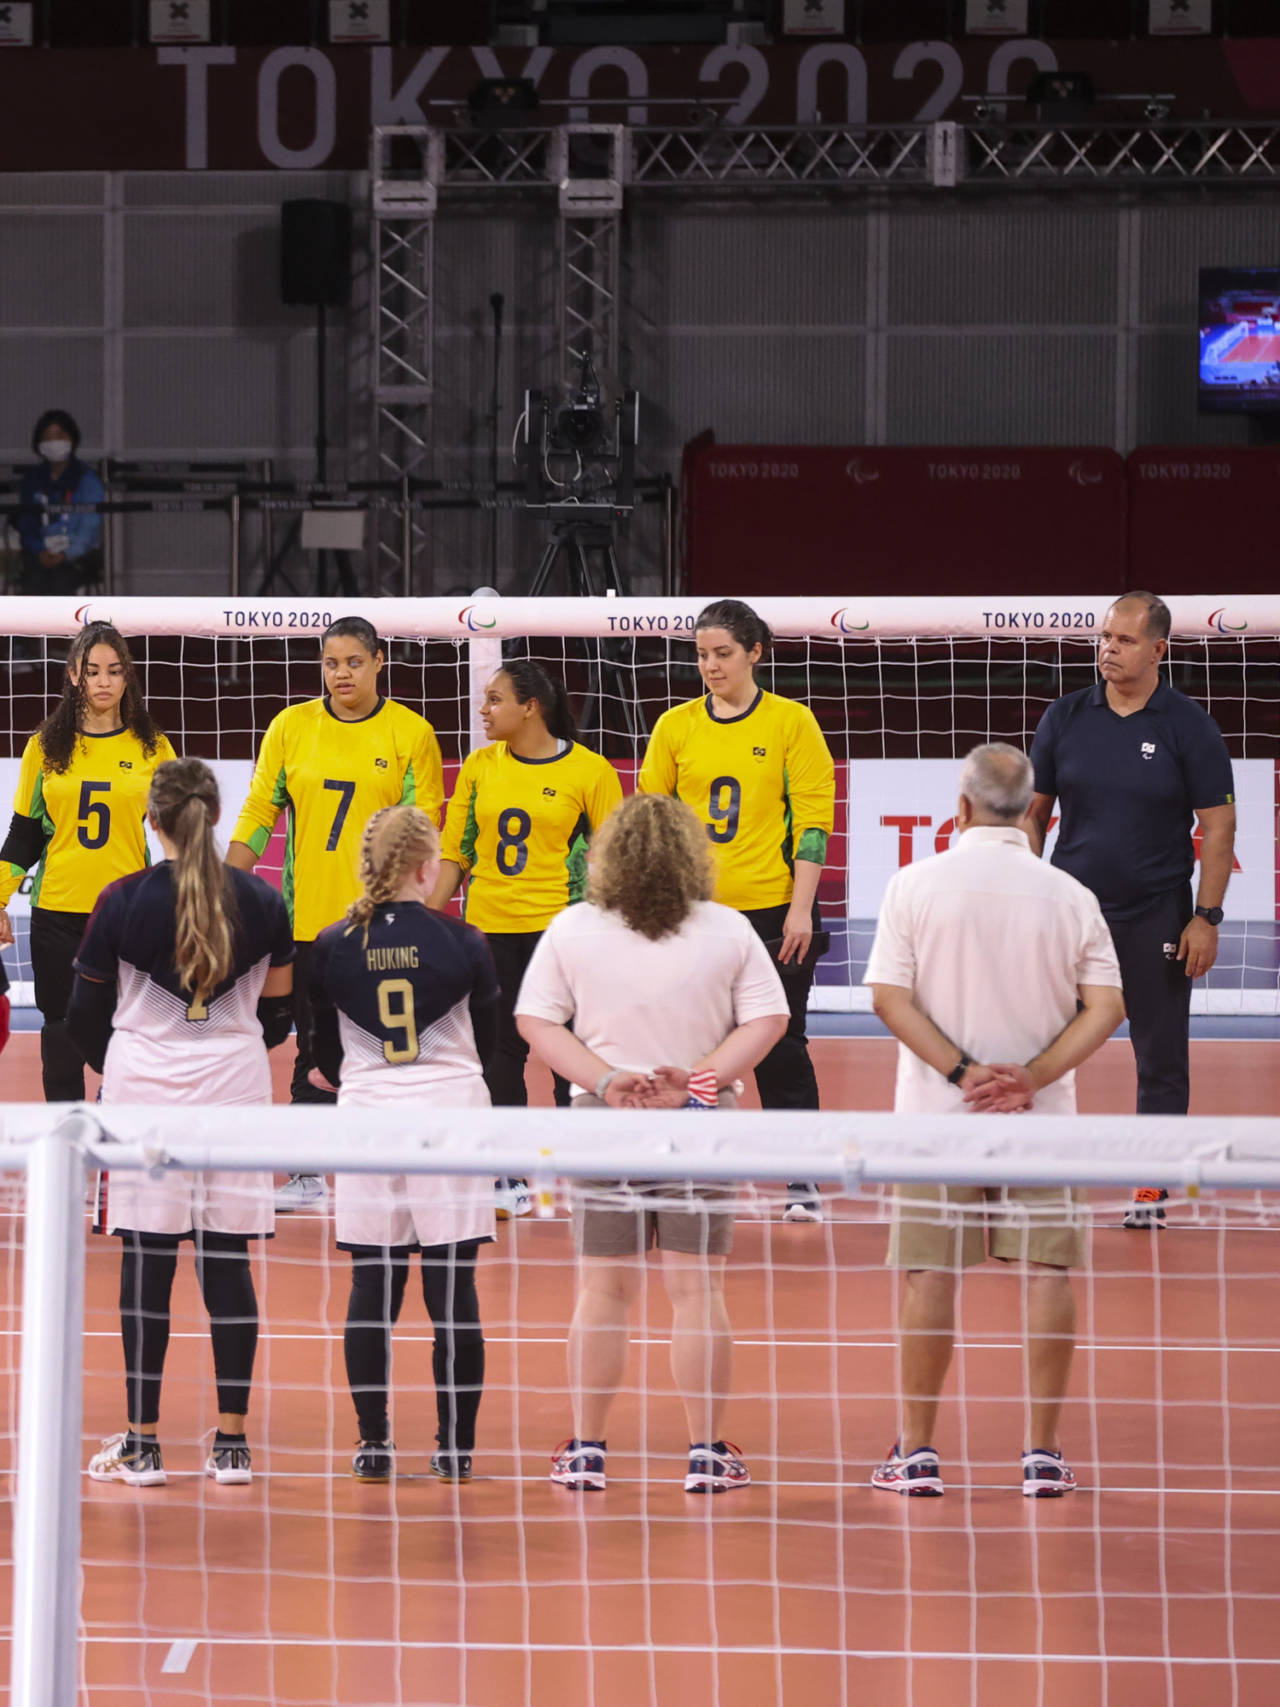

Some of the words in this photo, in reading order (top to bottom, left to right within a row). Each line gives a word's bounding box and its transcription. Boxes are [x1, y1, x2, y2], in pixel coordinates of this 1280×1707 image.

[223, 611, 283, 627] TOKYO
[288, 612, 332, 628] 2020
[607, 616, 668, 631] TOKYO
[673, 616, 696, 631] 20
[982, 612, 1045, 628] TOKYO
[1049, 612, 1095, 628] 2020
[77, 780, 112, 850] 5
[322, 779, 356, 852] 7
[496, 807, 532, 877] 8
[707, 775, 741, 844] 9
[367, 945, 419, 972] HUKING
[377, 978, 420, 1064] 9
